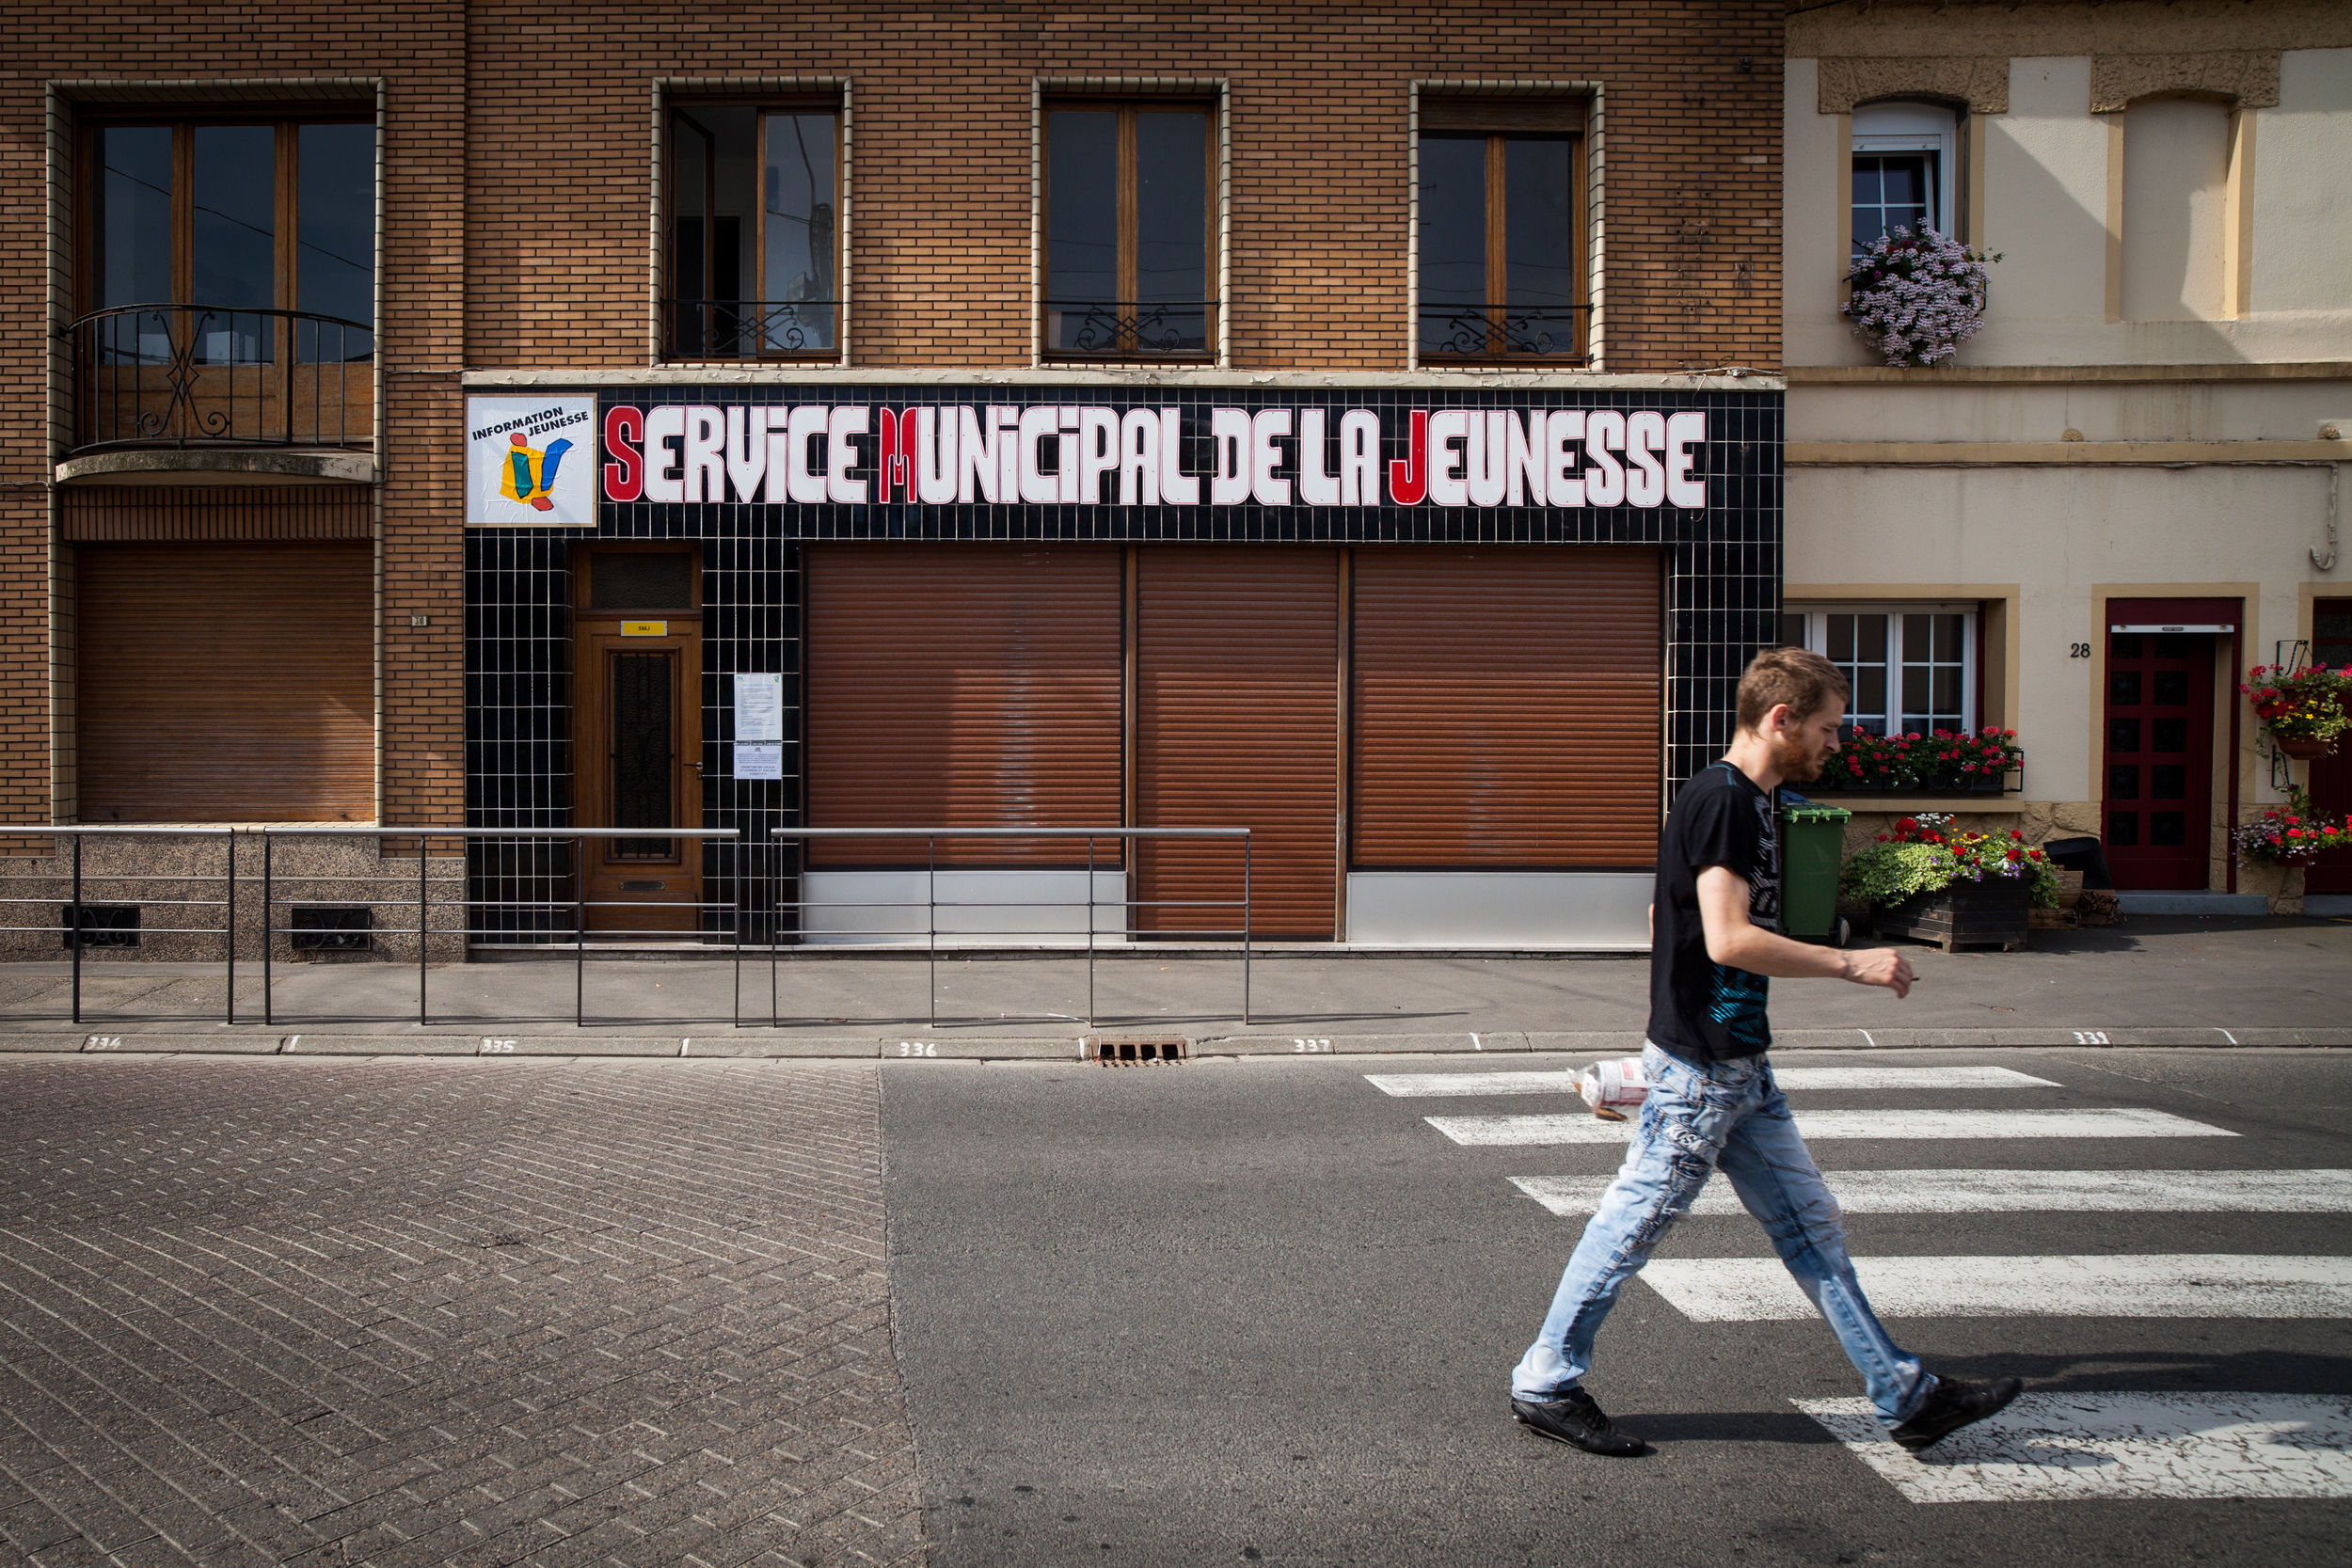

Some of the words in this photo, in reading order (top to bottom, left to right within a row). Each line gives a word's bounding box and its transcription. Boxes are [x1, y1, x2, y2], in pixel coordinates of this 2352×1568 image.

[472, 406, 564, 441] INFORMATION
[528, 411, 590, 437] JEUNESSE
[1211, 406, 1292, 505] DE
[1300, 408, 1381, 506] LA
[1388, 408, 1707, 508] JEUNESSE
[2070, 642, 2091, 658] 28
[87, 1037, 121, 1051] 334
[481, 1038, 516, 1053] 335
[1294, 1038, 1330, 1053] 337
[2072, 1031, 2111, 1045] 339
[899, 1041, 937, 1057] 336
